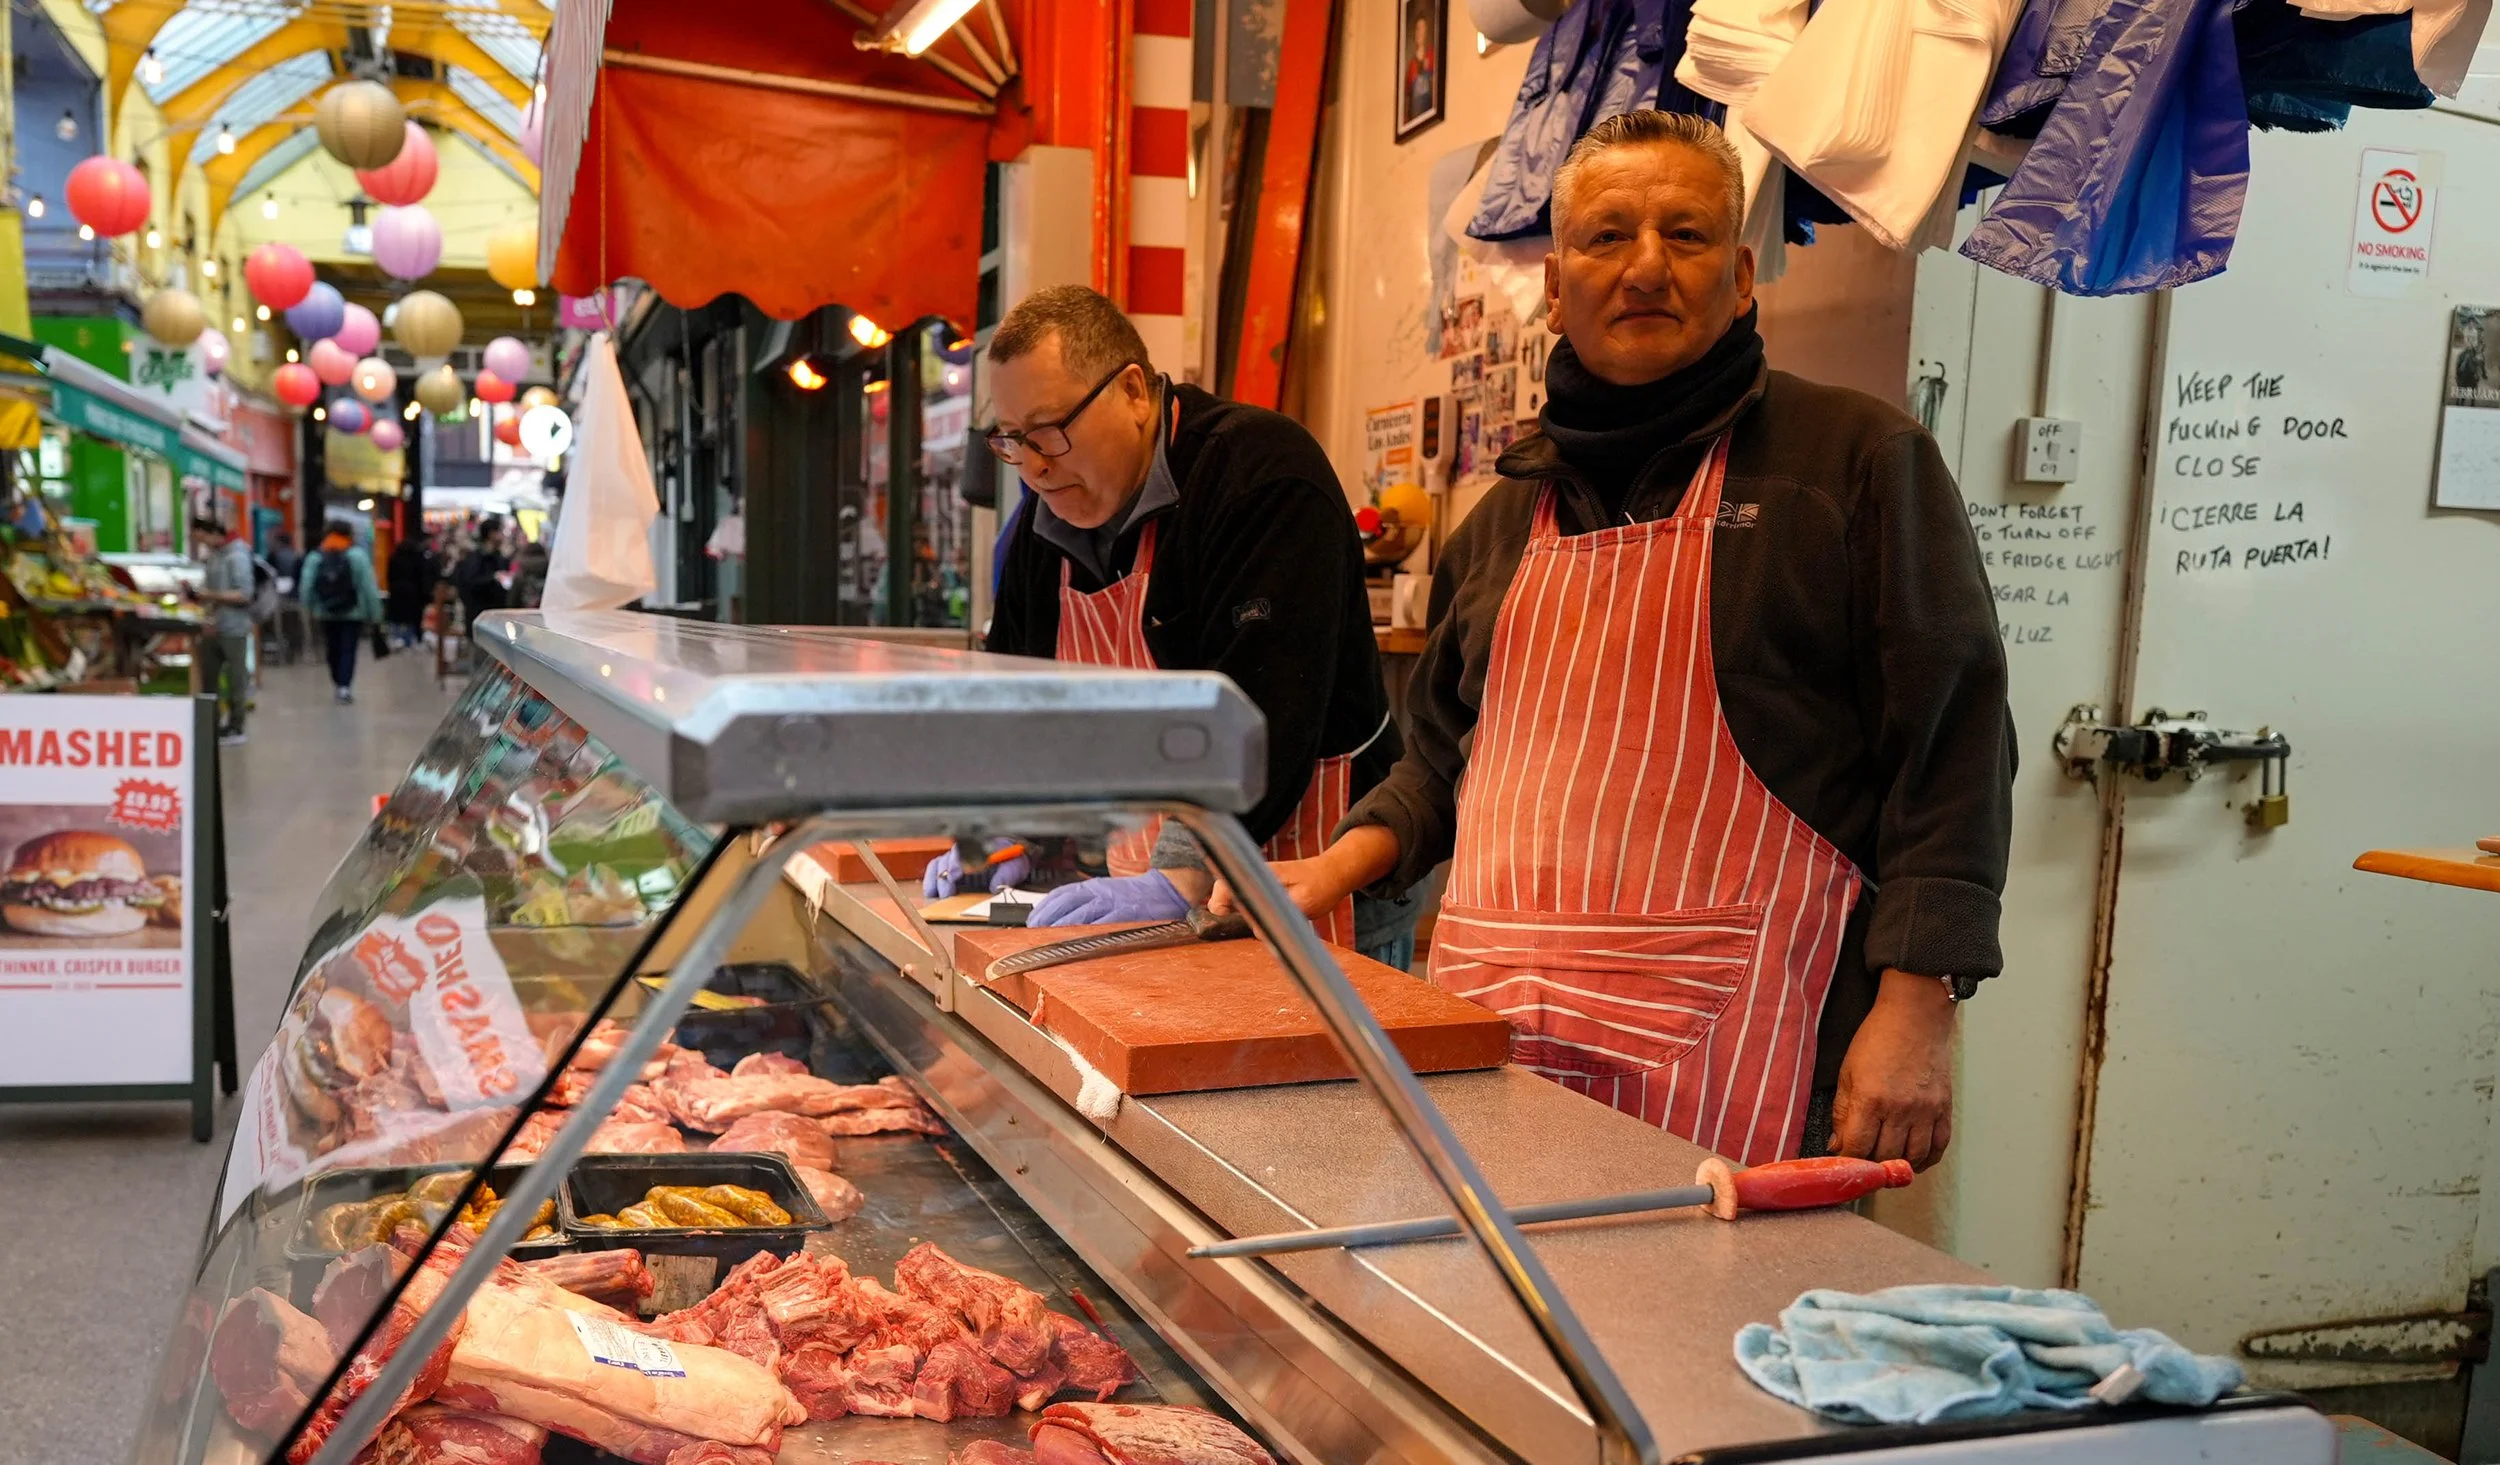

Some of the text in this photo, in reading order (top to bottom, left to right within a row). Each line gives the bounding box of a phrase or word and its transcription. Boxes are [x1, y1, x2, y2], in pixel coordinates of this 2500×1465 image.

[2358, 242, 2373, 256] NO
[2178, 371, 2285, 408] KEEP THE
[2284, 416, 2348, 441] DOOR
[2175, 454, 2261, 478] CLOSE
[1968, 503, 2084, 523] DONT FORGET
[2273, 501, 2304, 524] LA
[1998, 524, 2051, 540] TURN
[2058, 526, 2096, 540] OFF
[2002, 550, 2067, 570] FRIDGE
[2244, 535, 2331, 570] PUERTA!
[2045, 589, 2070, 606] LA
[2014, 624, 2053, 644] LUZ
[0, 729, 182, 767] MASHED
[64, 958, 122, 975] CRISPER
[127, 958, 182, 975] BURGER
